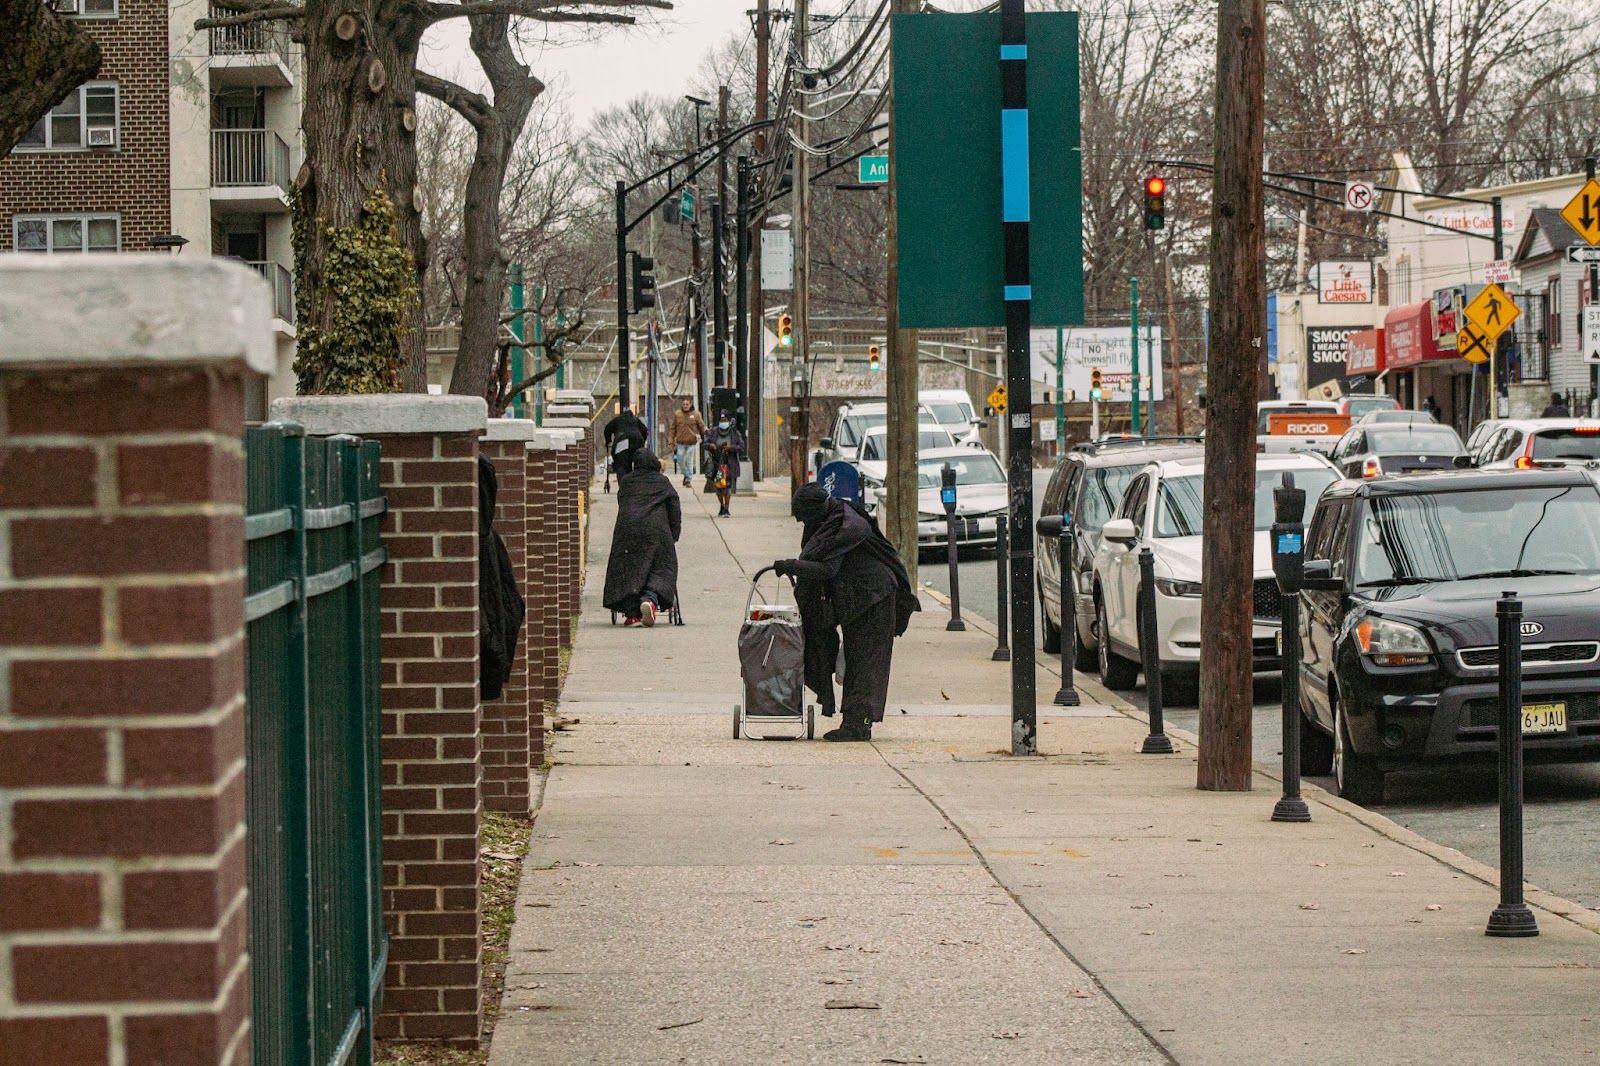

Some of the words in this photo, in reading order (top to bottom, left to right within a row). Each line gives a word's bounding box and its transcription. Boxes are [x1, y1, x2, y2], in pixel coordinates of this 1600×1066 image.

[1444, 216, 1471, 229] Little
[1472, 215, 1513, 229] Caesrs
[1333, 279, 1362, 291] Little
[1324, 289, 1367, 302] Caesars
[1317, 342, 1339, 351] MEAN
[1460, 336, 1468, 346] R
[1088, 345, 1102, 354] NO
[1287, 423, 1329, 434] RIDGID
[1540, 710, 1563, 727] JAU
